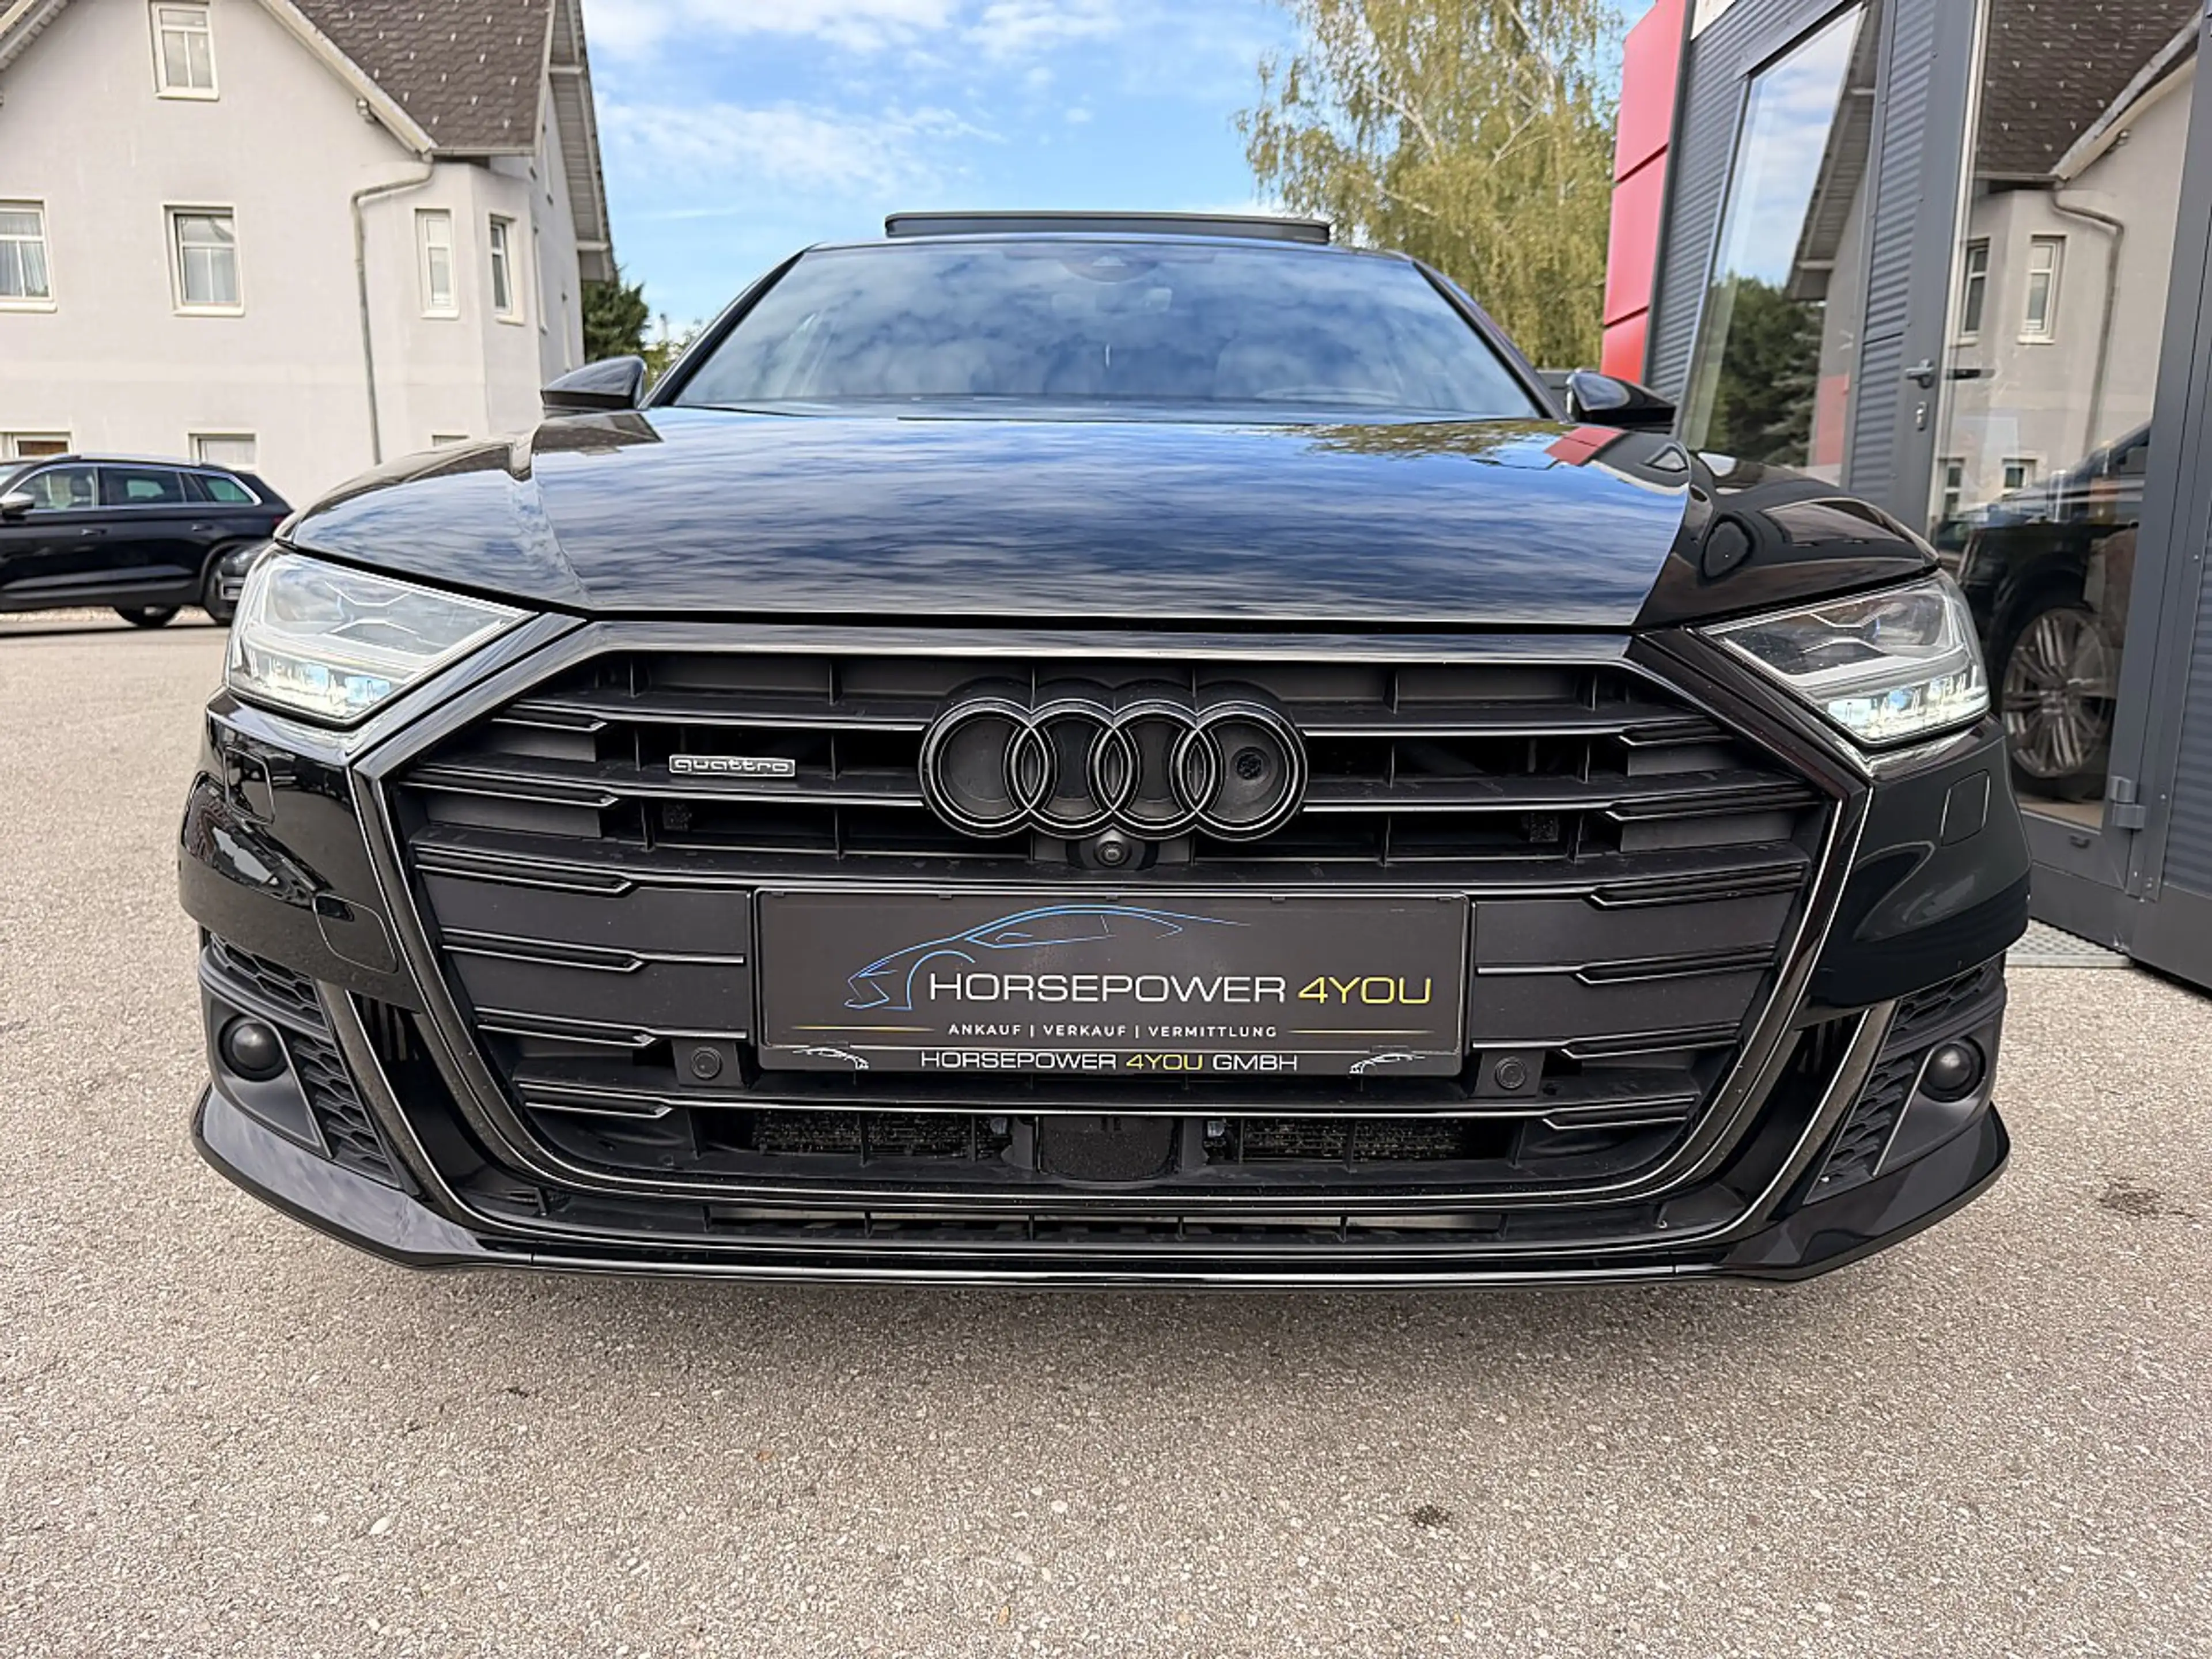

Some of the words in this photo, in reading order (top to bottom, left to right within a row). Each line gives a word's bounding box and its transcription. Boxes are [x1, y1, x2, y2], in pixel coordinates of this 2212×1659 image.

[674, 759, 790, 772] quattro
[930, 973, 1286, 1003] HORSEPOWER
[1297, 976, 1432, 1005] 4YOU
[948, 1024, 1022, 1036] ANKAUF
[1043, 1024, 1127, 1037] VERKAUF
[1148, 1026, 1277, 1037] VERMITTLUNG
[921, 1051, 1116, 1070] HORSEPOWER
[1125, 1054, 1203, 1070] 4YOU
[1212, 1054, 1298, 1071] GMBH
